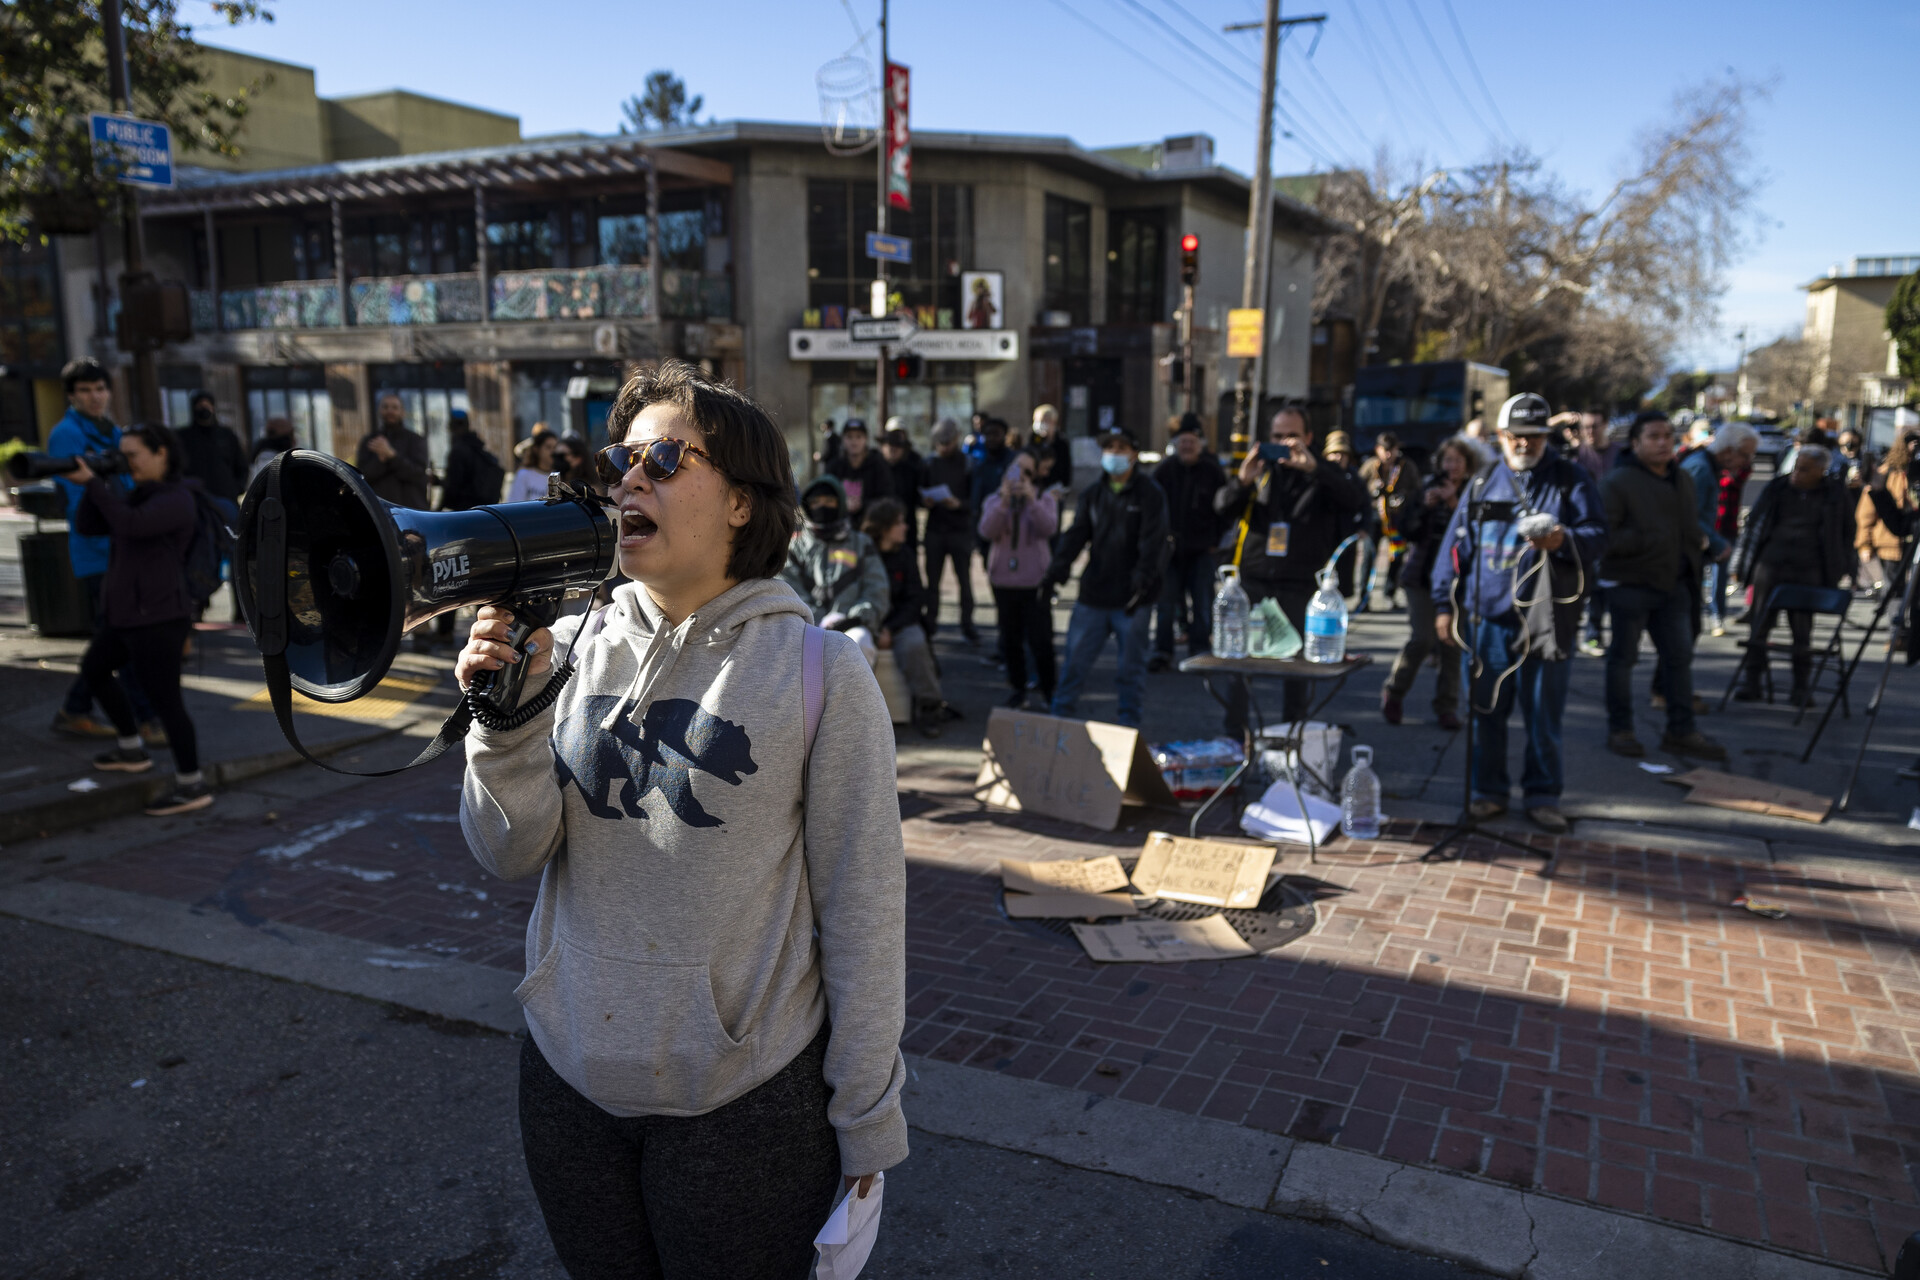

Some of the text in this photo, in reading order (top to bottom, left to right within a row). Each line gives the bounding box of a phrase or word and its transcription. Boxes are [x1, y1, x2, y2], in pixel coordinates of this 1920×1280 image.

[106, 121, 154, 146] PUBLIC
[95, 143, 169, 166] ROOM
[432, 554, 470, 584] PYLE
